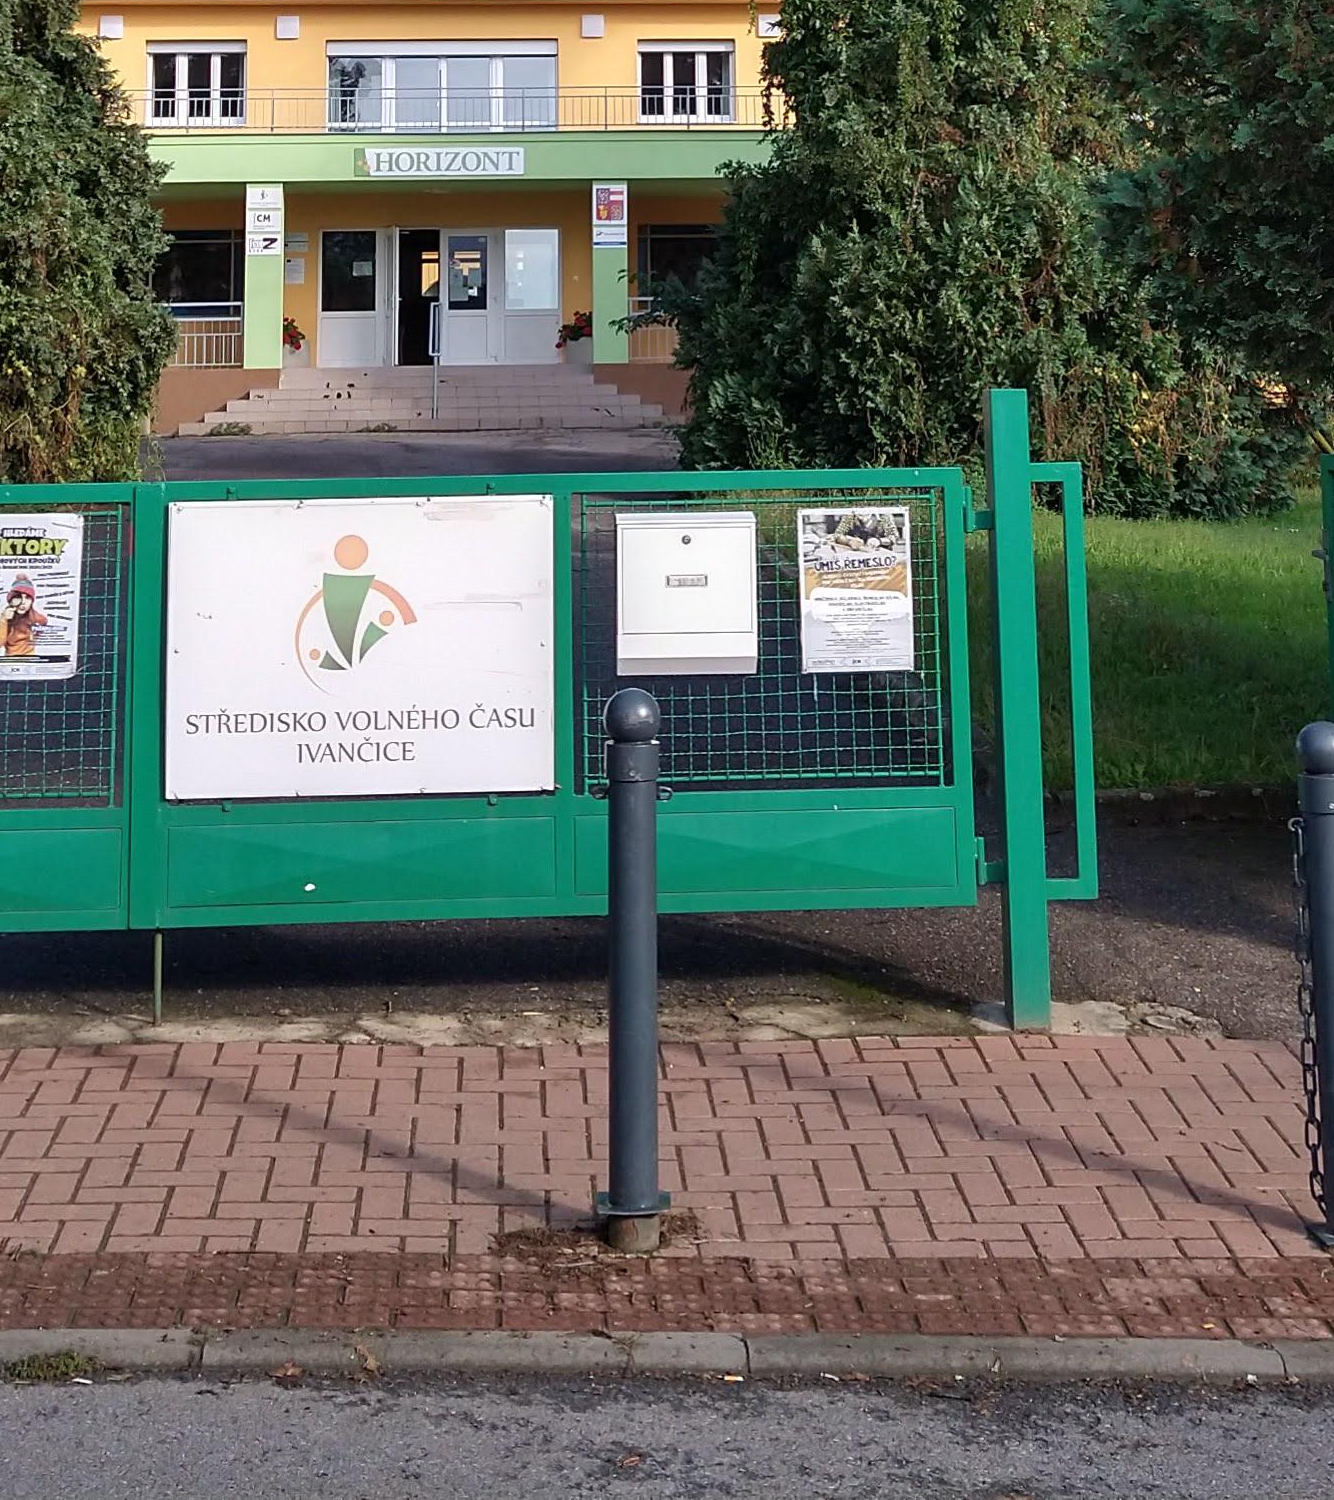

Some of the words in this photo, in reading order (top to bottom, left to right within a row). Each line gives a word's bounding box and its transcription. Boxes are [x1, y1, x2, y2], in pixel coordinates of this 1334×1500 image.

[374, 151, 520, 172] HORIZONT
[3, 526, 45, 538] HLEDÁME
[844, 556, 897, 569] ŘEMESLO?
[186, 708, 327, 735] STŘEDISKO
[334, 704, 460, 732] VOLNÉHO
[469, 703, 535, 730] ČASU
[297, 737, 416, 764] IVANČICE
